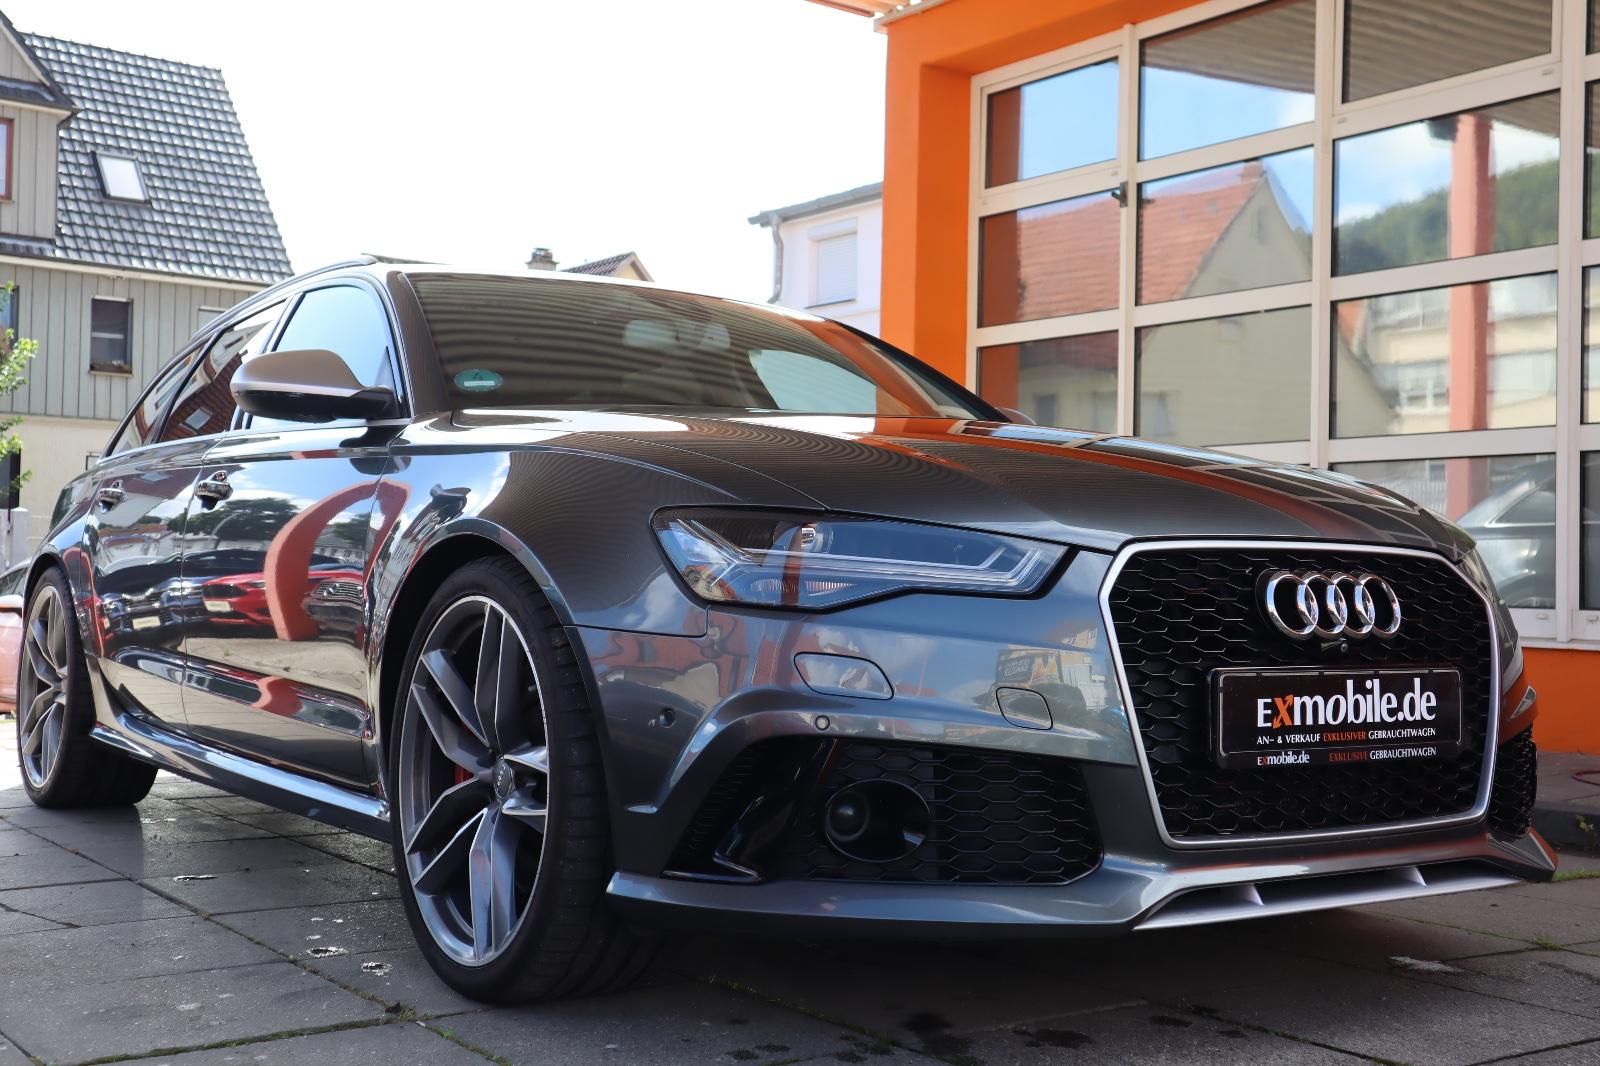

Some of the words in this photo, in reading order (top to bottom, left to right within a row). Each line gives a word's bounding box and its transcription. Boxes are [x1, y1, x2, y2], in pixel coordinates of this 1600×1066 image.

[1256, 735, 1275, 745] AN-
[1277, 735, 1283, 744] &
[1285, 733, 1321, 744] VERKAUF
[1323, 731, 1367, 742] EXKLUSIVER
[1368, 727, 1437, 740] GEBRAUCHTWAGEN
[1369, 746, 1437, 760] GEBRAUCHTWAGEN
